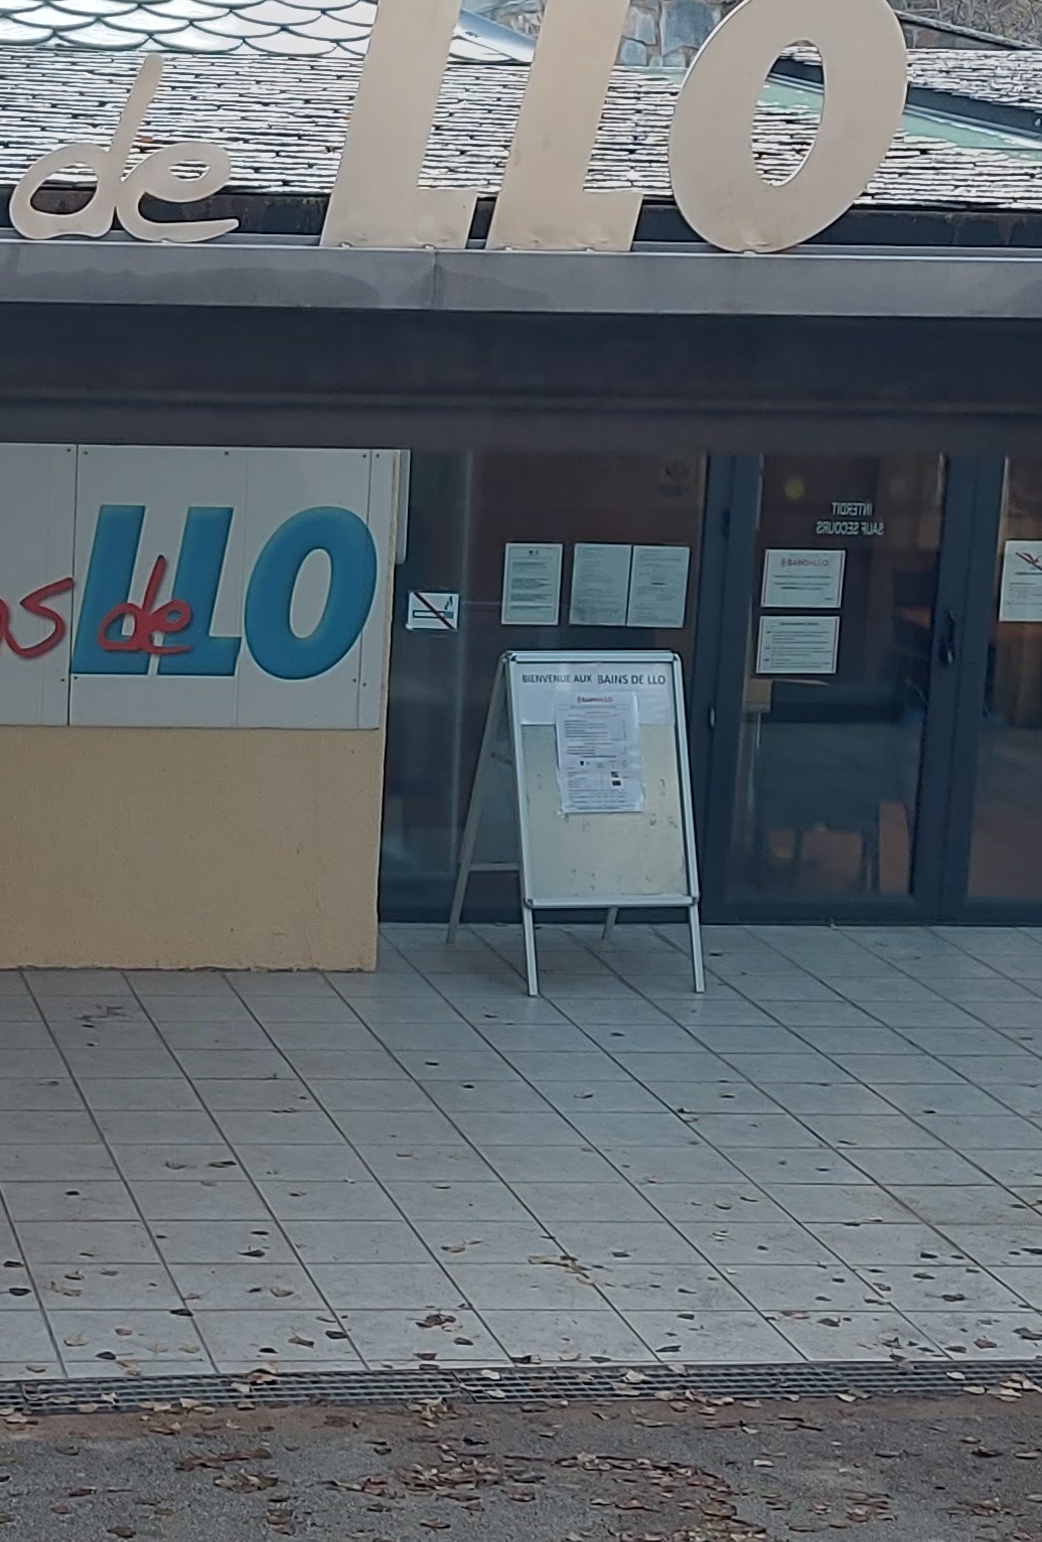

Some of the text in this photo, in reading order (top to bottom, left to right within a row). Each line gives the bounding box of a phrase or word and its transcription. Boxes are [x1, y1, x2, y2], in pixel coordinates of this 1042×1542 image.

[9, 53, 240, 242] de
[70, 505, 378, 681] LLO
[96, 554, 193, 657] de
[522, 674, 667, 685] BIENVENUE AUX BAINS DE LLO
